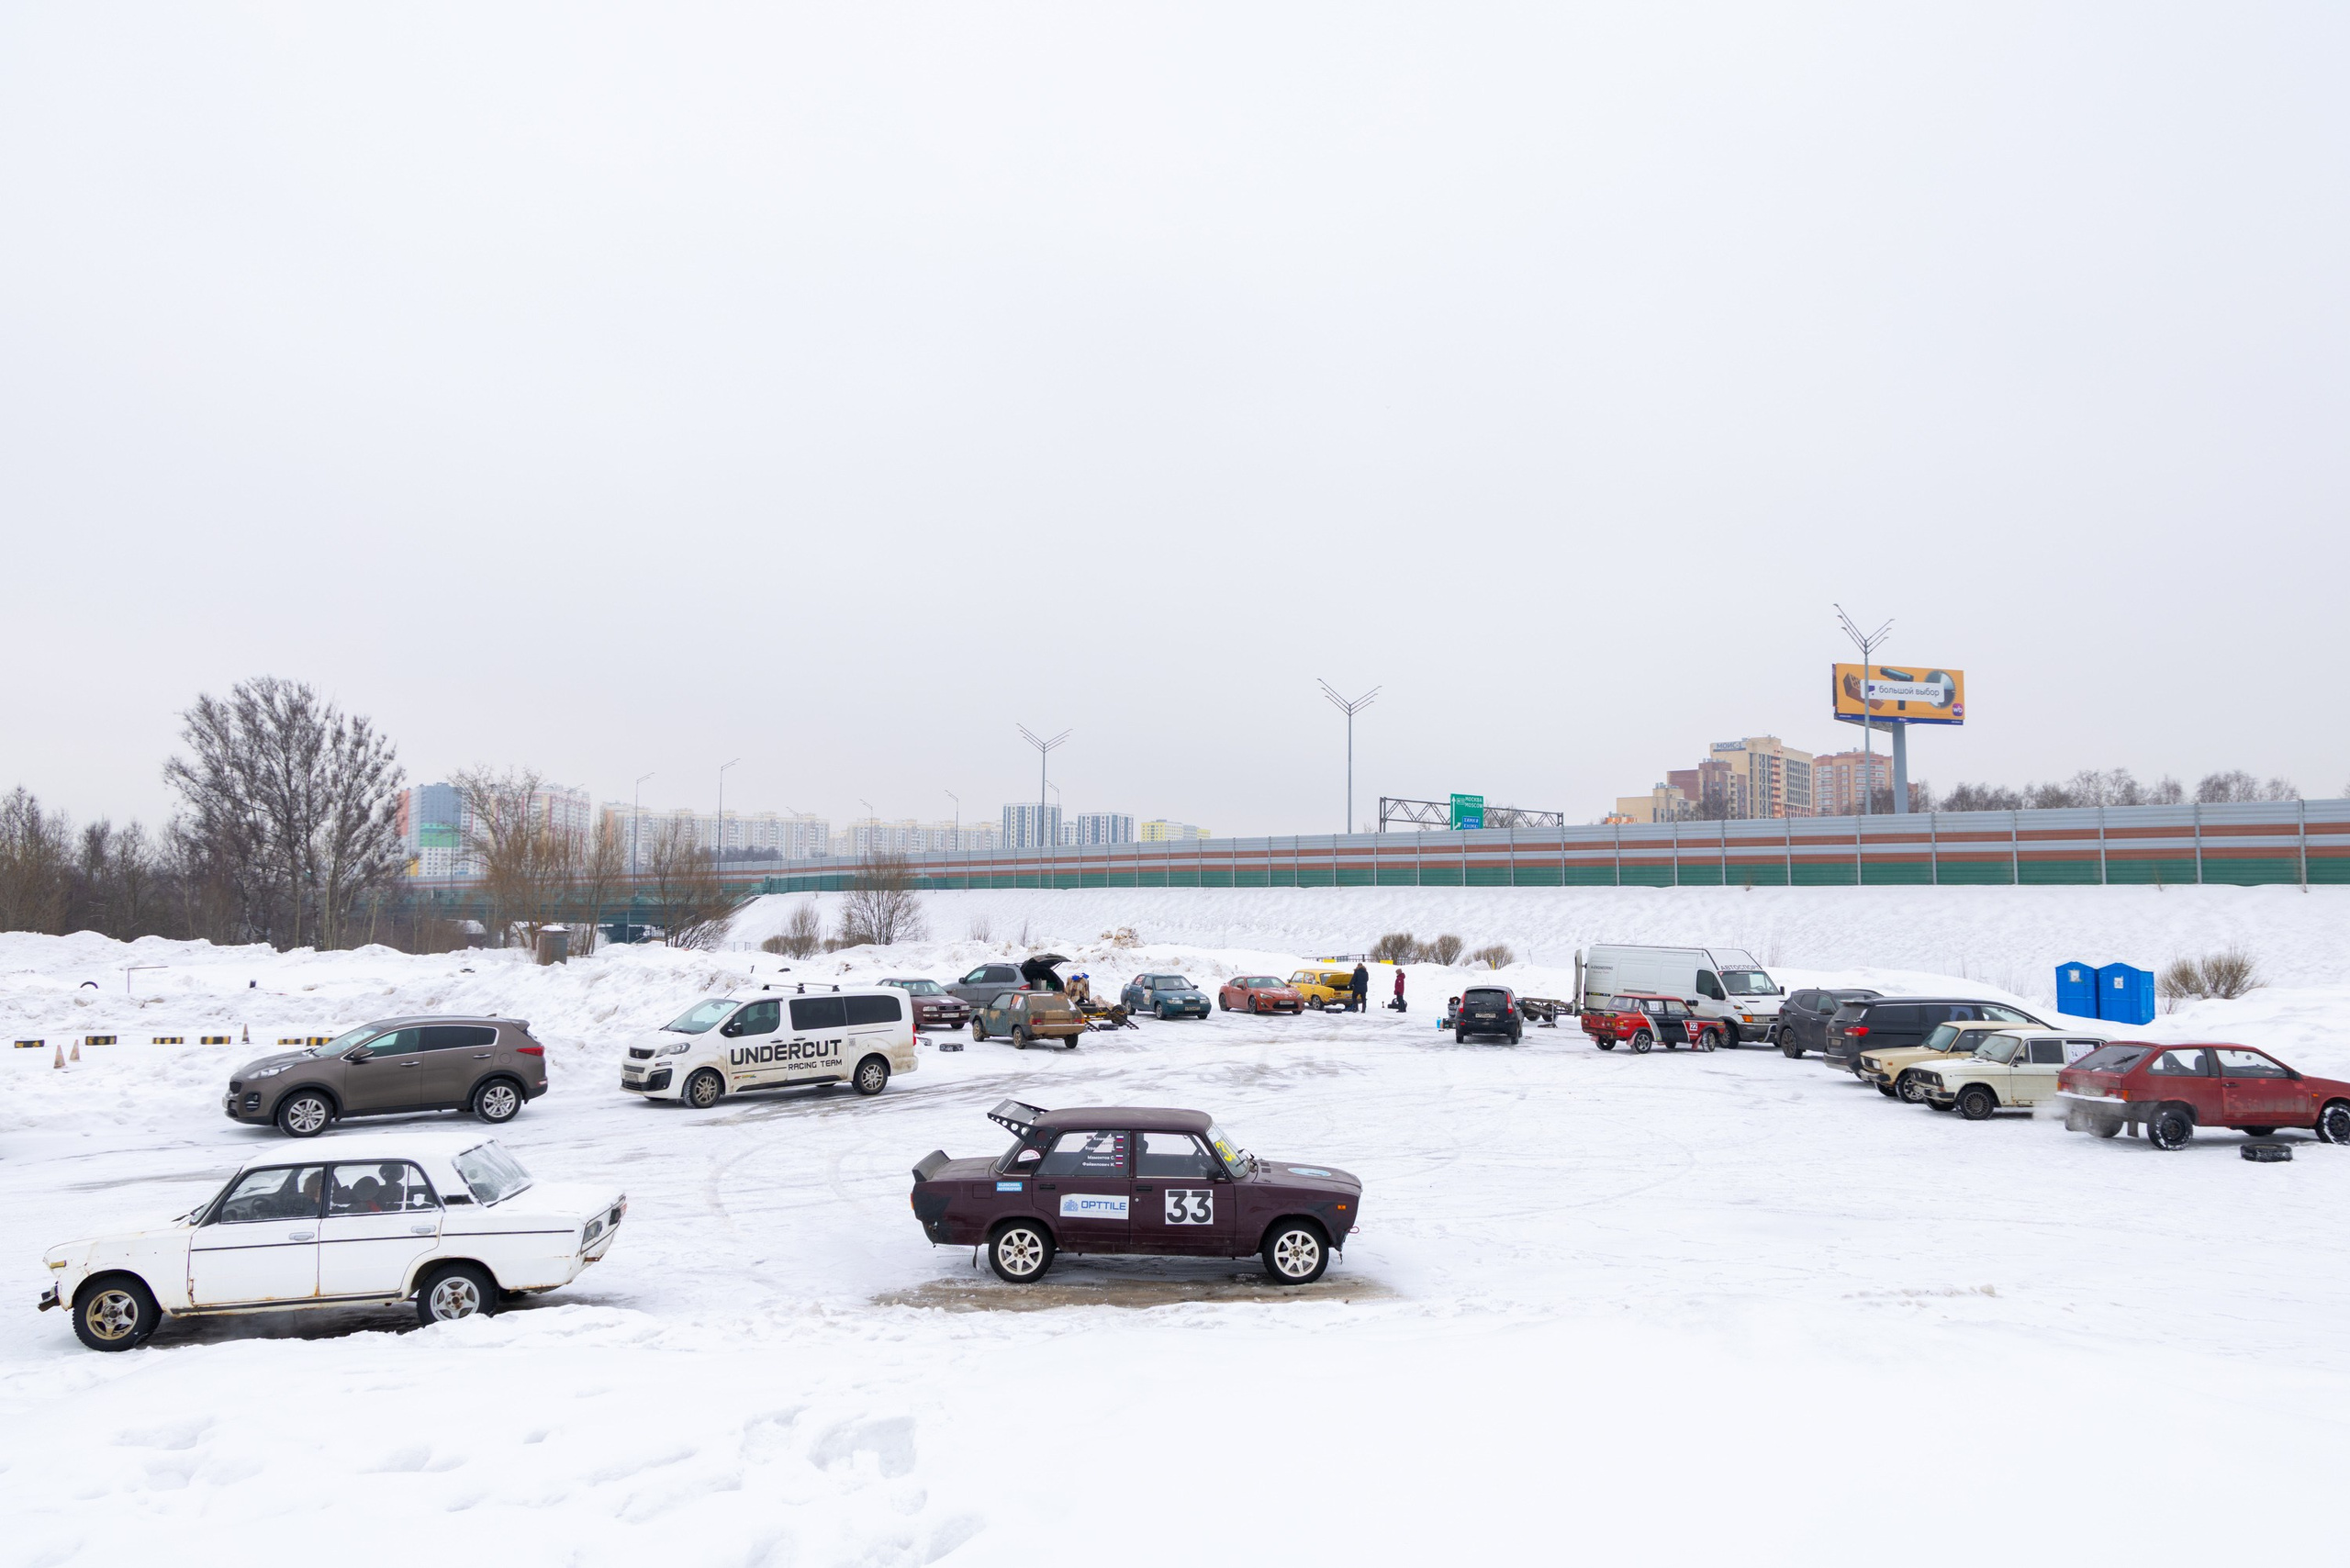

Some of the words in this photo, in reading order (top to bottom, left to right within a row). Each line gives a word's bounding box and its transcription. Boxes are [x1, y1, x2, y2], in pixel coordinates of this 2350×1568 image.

[1878, 685, 1914, 695] большой
[1915, 687, 1940, 697] выбор
[1953, 705, 1963, 713] wb
[731, 1039, 842, 1066] UNDERCUT
[788, 1061, 817, 1070] RACING
[821, 1059, 843, 1068] TEAM
[1080, 1200, 1126, 1211] OPTTILE
[1166, 1190, 1212, 1224] 33
